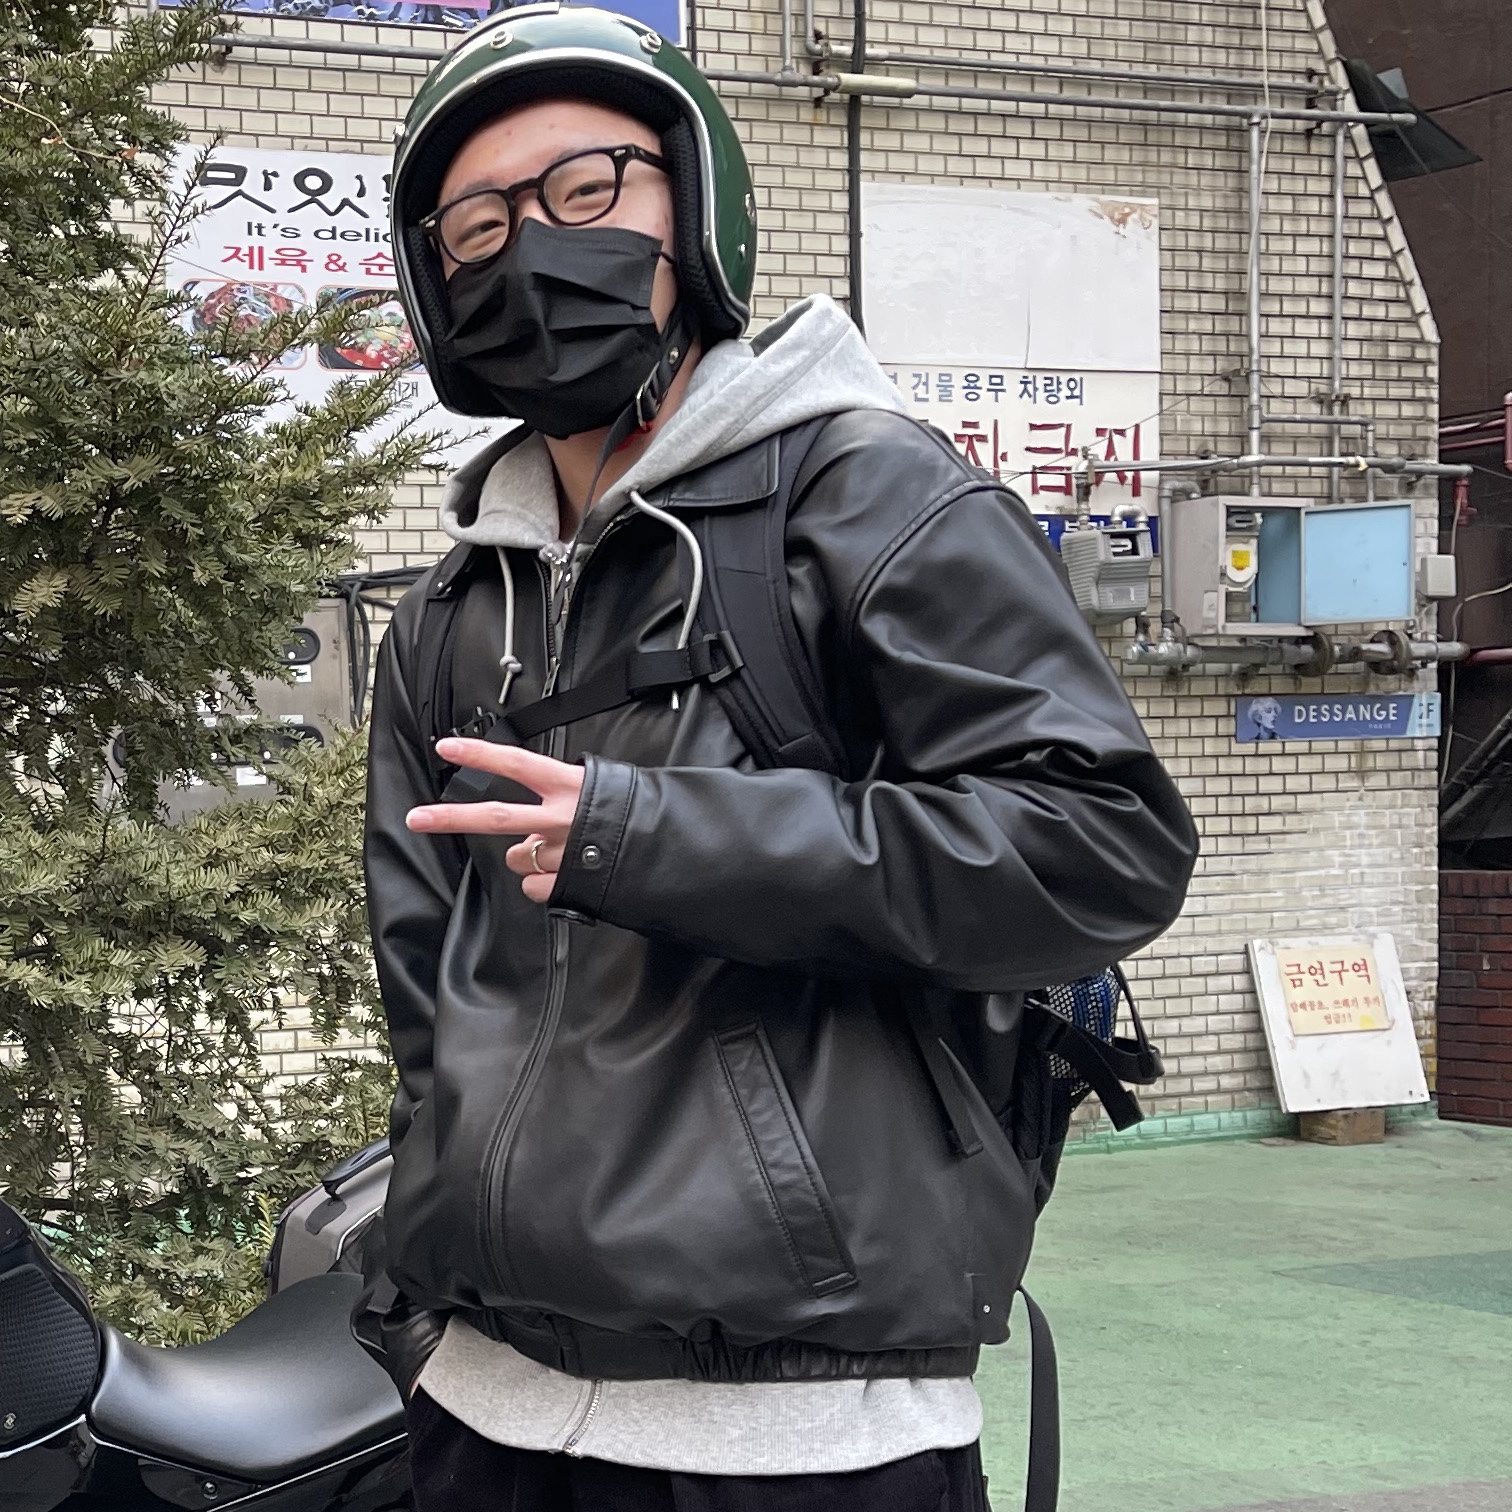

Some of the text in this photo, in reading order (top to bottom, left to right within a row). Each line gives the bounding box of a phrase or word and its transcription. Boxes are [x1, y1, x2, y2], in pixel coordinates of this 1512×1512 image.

[197, 163, 391, 218] 맛있
[246, 221, 301, 239] It's
[221, 245, 314, 273] 제육
[324, 252, 349, 272] &
[911, 371, 1007, 403] 건물용무
[1018, 374, 1085, 406] 차량외
[918, 418, 1143, 497] 차금지
[1294, 702, 1398, 723] DESSANGE
[1284, 958, 1371, 989] 금연구역
